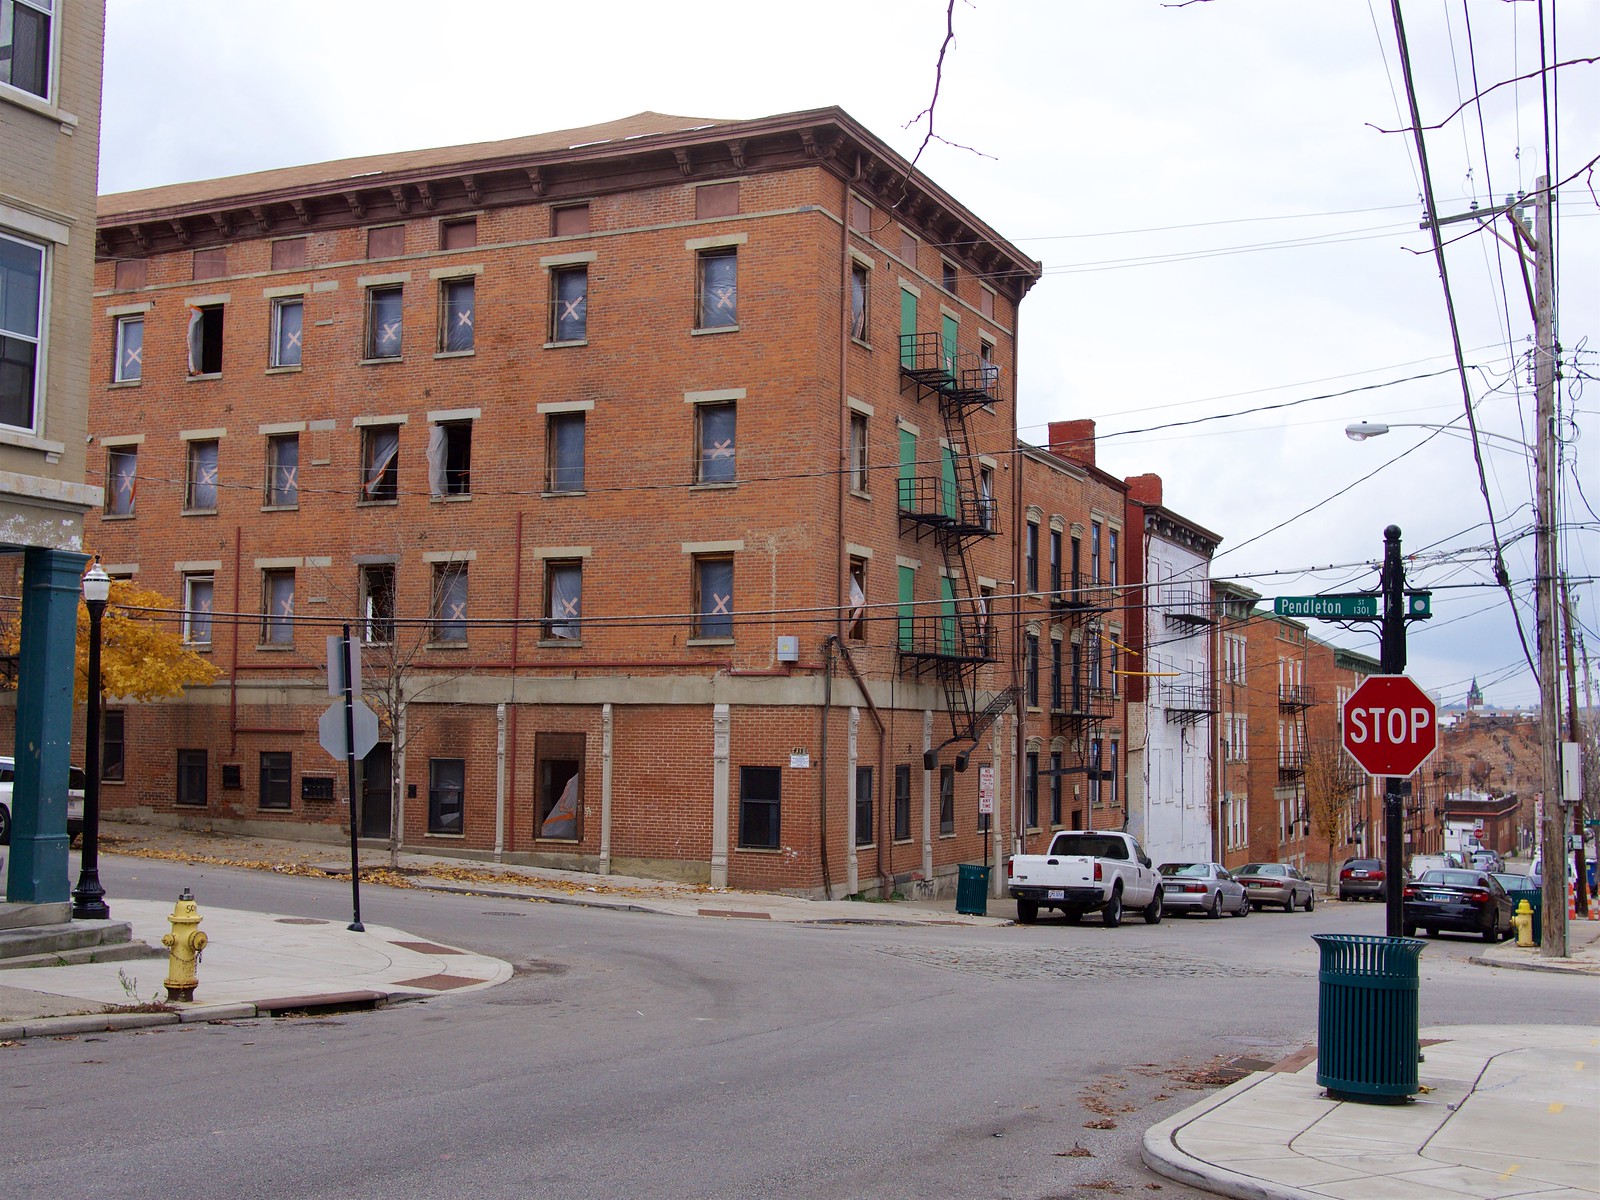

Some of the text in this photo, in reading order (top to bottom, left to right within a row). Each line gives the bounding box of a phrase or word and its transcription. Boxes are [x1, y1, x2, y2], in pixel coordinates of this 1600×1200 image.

[1281, 599, 1341, 614] Pendleton
[1353, 606, 1370, 614] 1301
[1350, 707, 1430, 744] STOP
